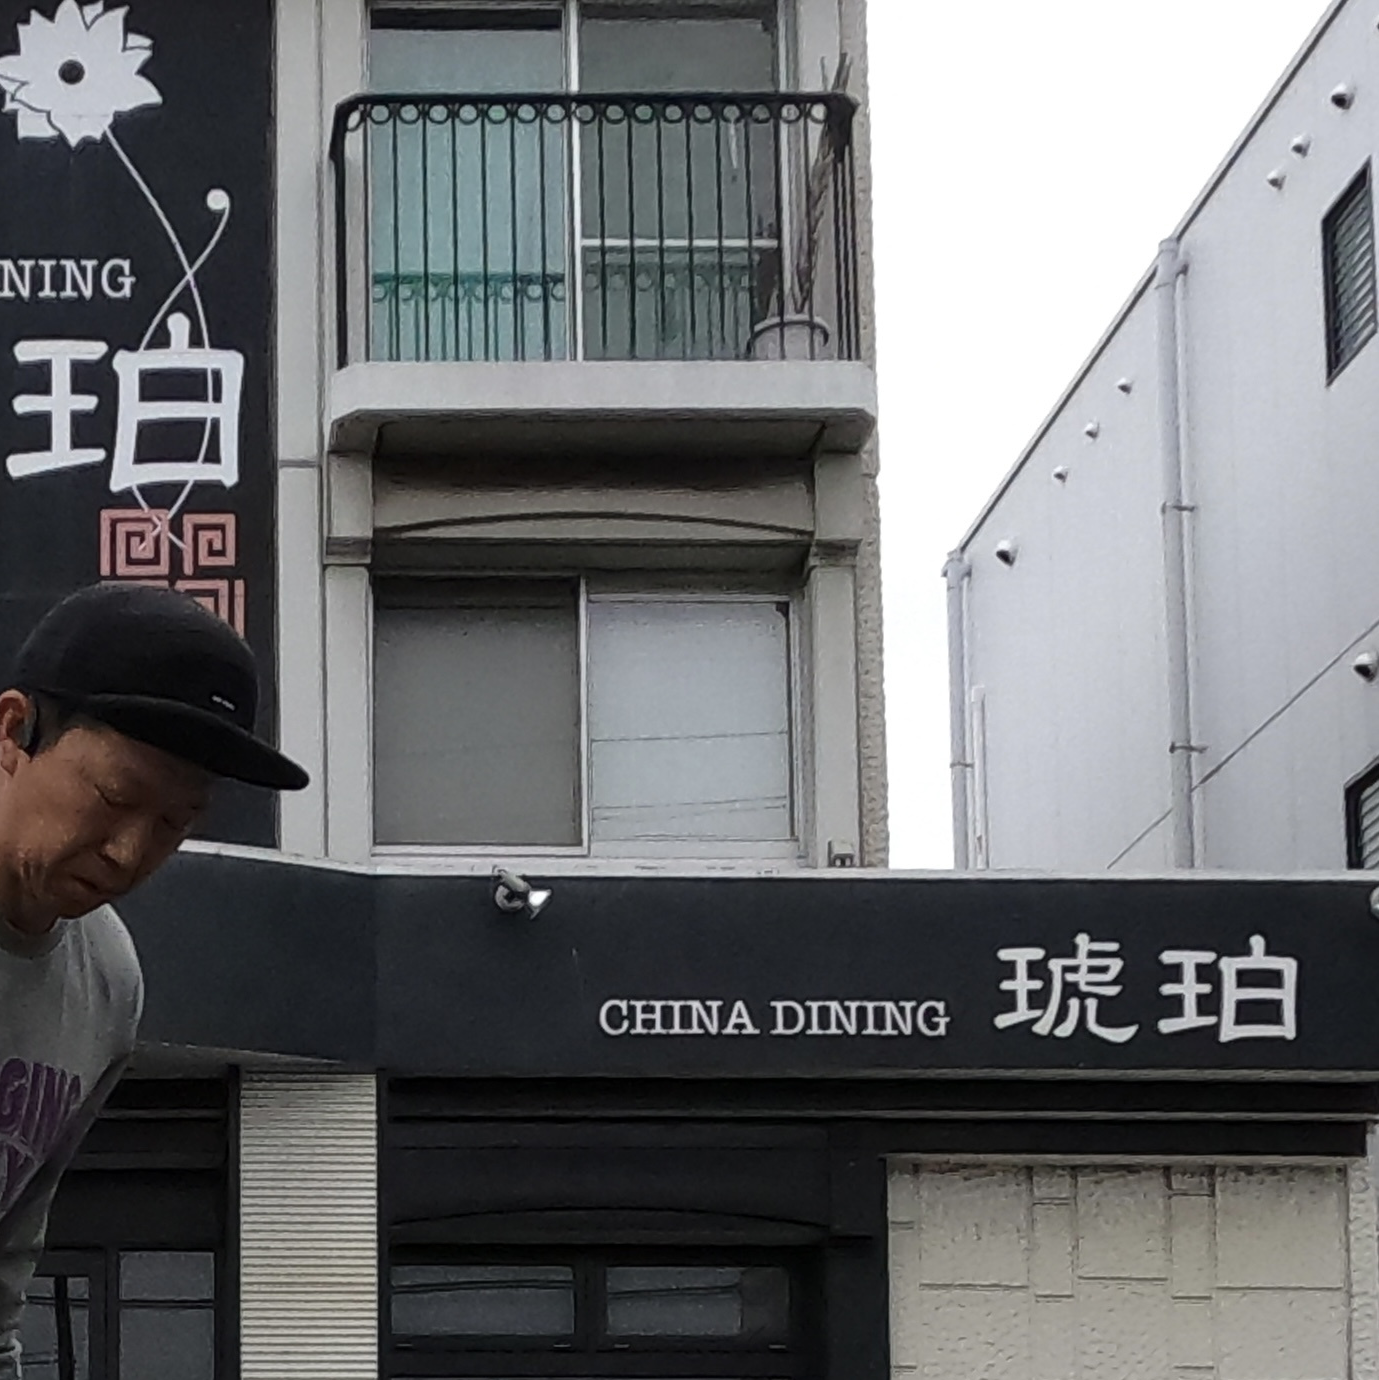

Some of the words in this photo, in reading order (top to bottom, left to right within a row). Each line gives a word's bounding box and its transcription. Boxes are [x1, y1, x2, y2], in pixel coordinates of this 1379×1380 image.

[599, 999, 761, 1036] CHINA
[770, 1000, 951, 1037] DINING
[993, 932, 1299, 1044] 琥珀
